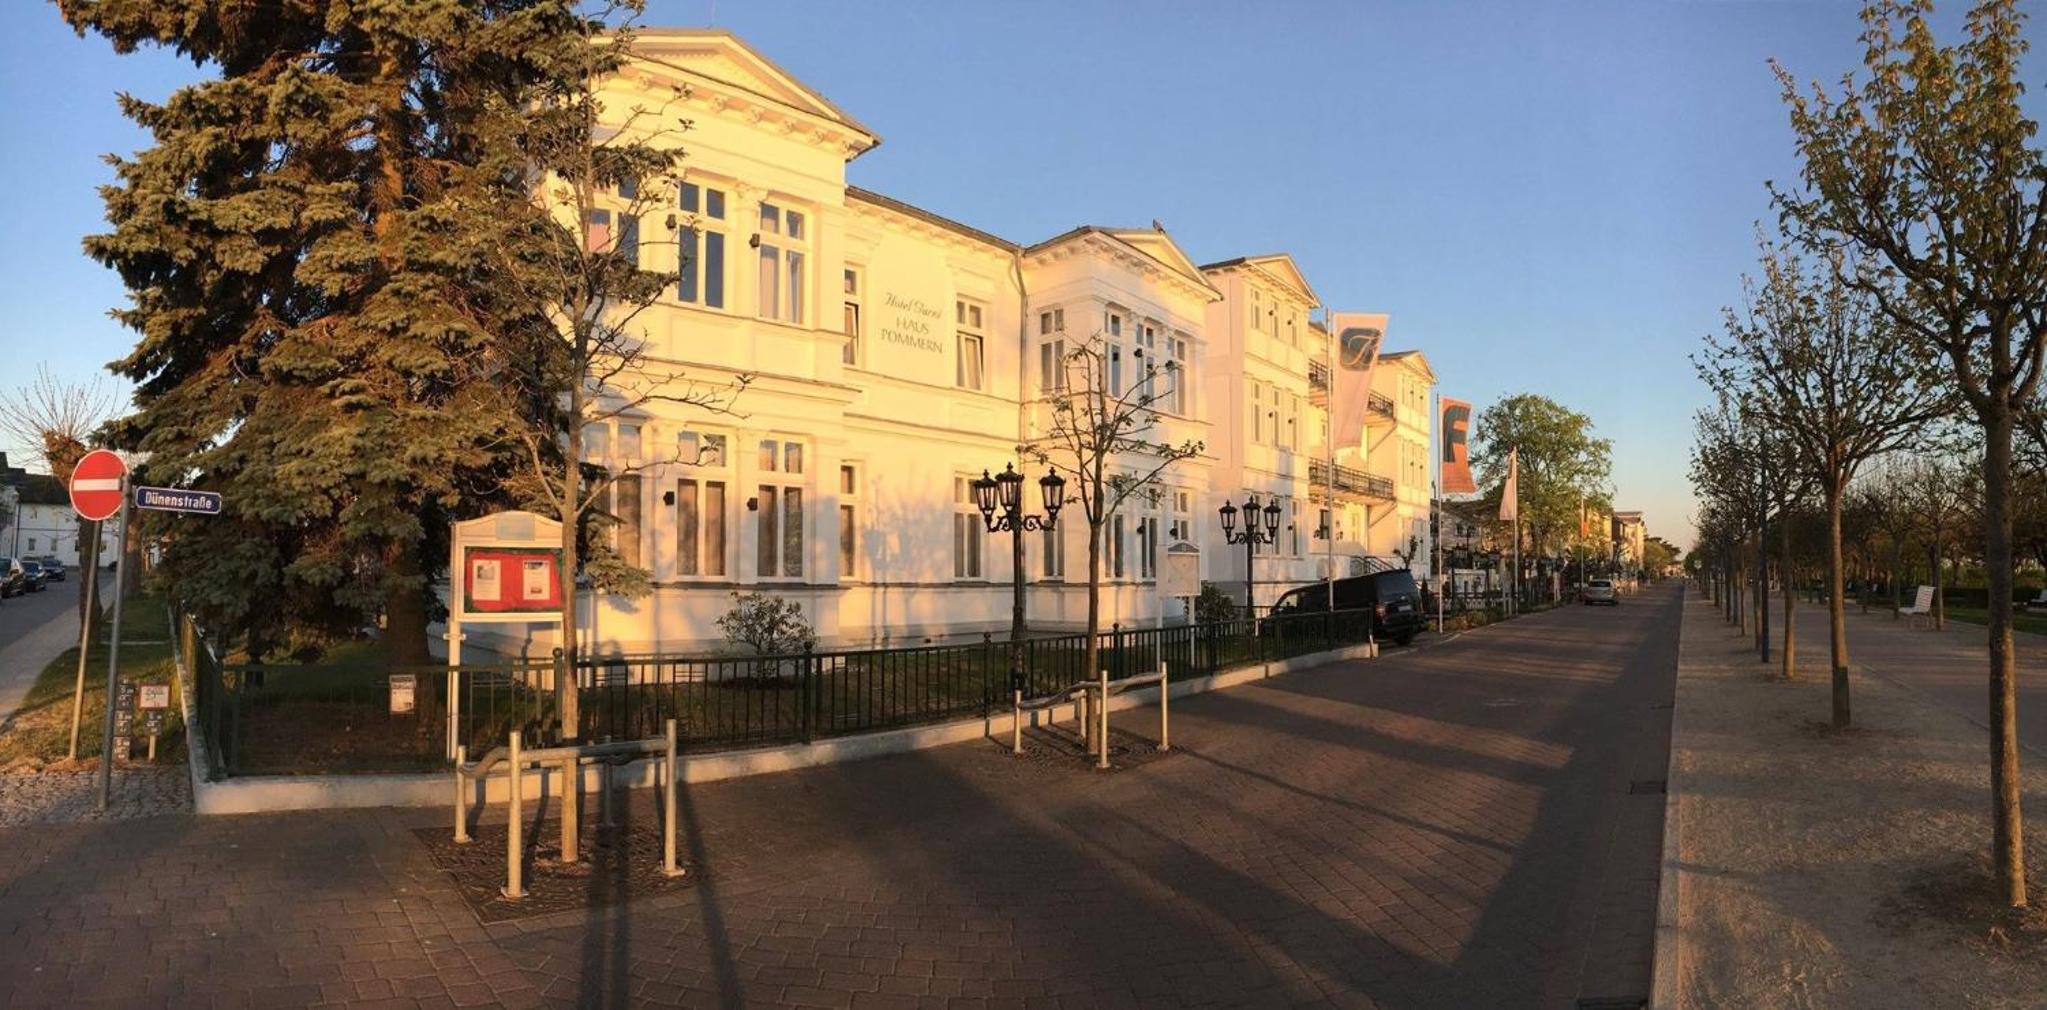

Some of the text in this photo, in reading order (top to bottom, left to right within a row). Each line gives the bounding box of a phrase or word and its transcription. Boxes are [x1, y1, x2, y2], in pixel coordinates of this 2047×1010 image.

[885, 292, 913, 311] Hotel
[896, 316, 929, 335] HAUS
[881, 328, 943, 355] POMMERN
[145, 490, 213, 510] Dünenstraße
